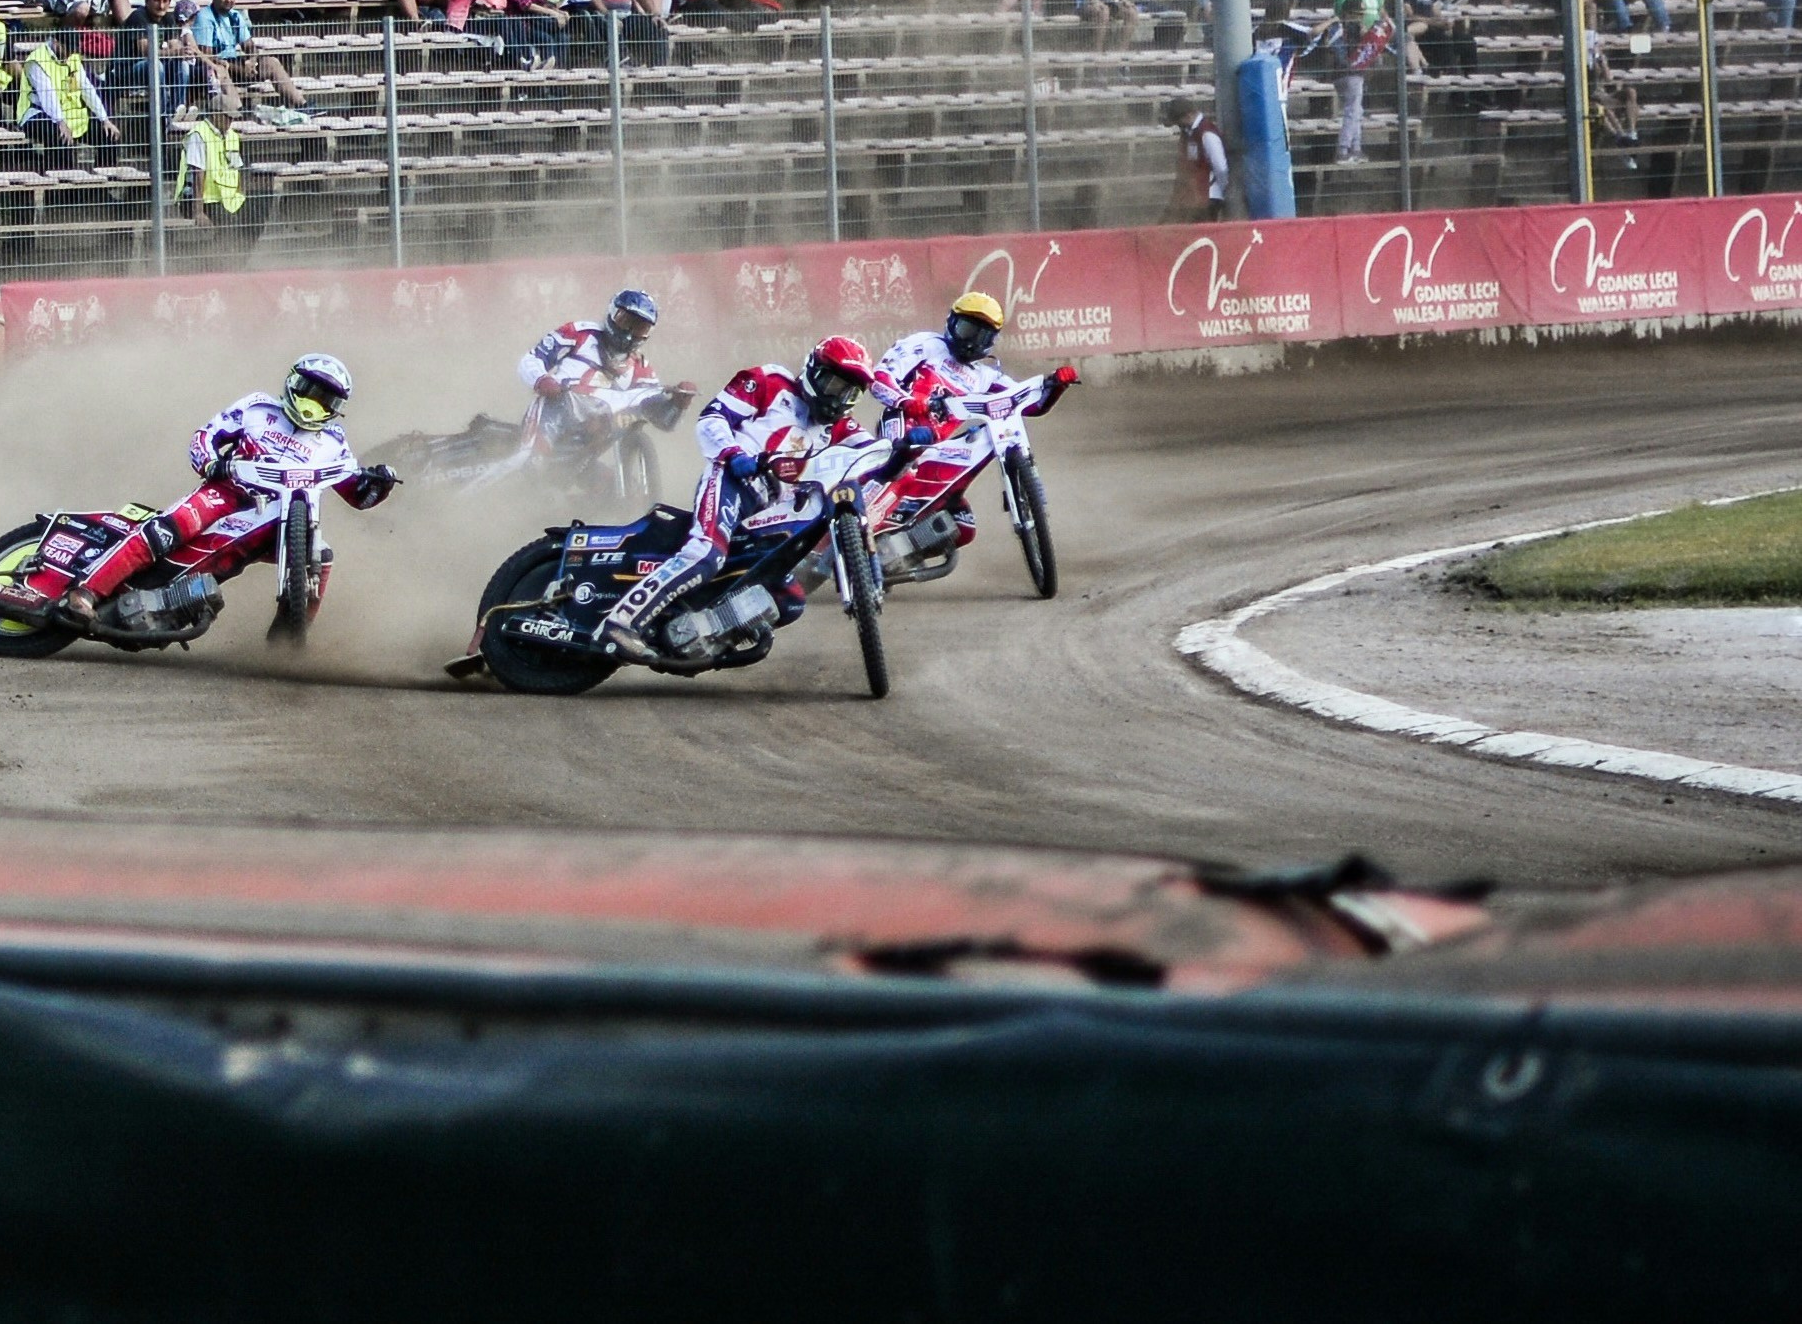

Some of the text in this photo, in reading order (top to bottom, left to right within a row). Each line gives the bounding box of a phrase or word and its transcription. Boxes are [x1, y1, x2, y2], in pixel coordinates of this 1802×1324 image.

[1414, 281, 1500, 304] GDANSK LECH
[1597, 271, 1678, 293] GDANSK LECH
[1578, 291, 1678, 314] WALESA AIRPORT
[1751, 284, 1796, 303] WALESA
[1220, 294, 1311, 317] GDANSK LECH
[1393, 301, 1500, 325] WALESA AIRPORT
[1017, 306, 1112, 330] GDANSK LECH
[1199, 314, 1311, 338] WALESA AIRPORT
[1056, 326, 1112, 348] AIRPORT
[44, 545, 73, 565] TEAM
[591, 552, 627, 563] LTE
[521, 621, 574, 641] CHROM
